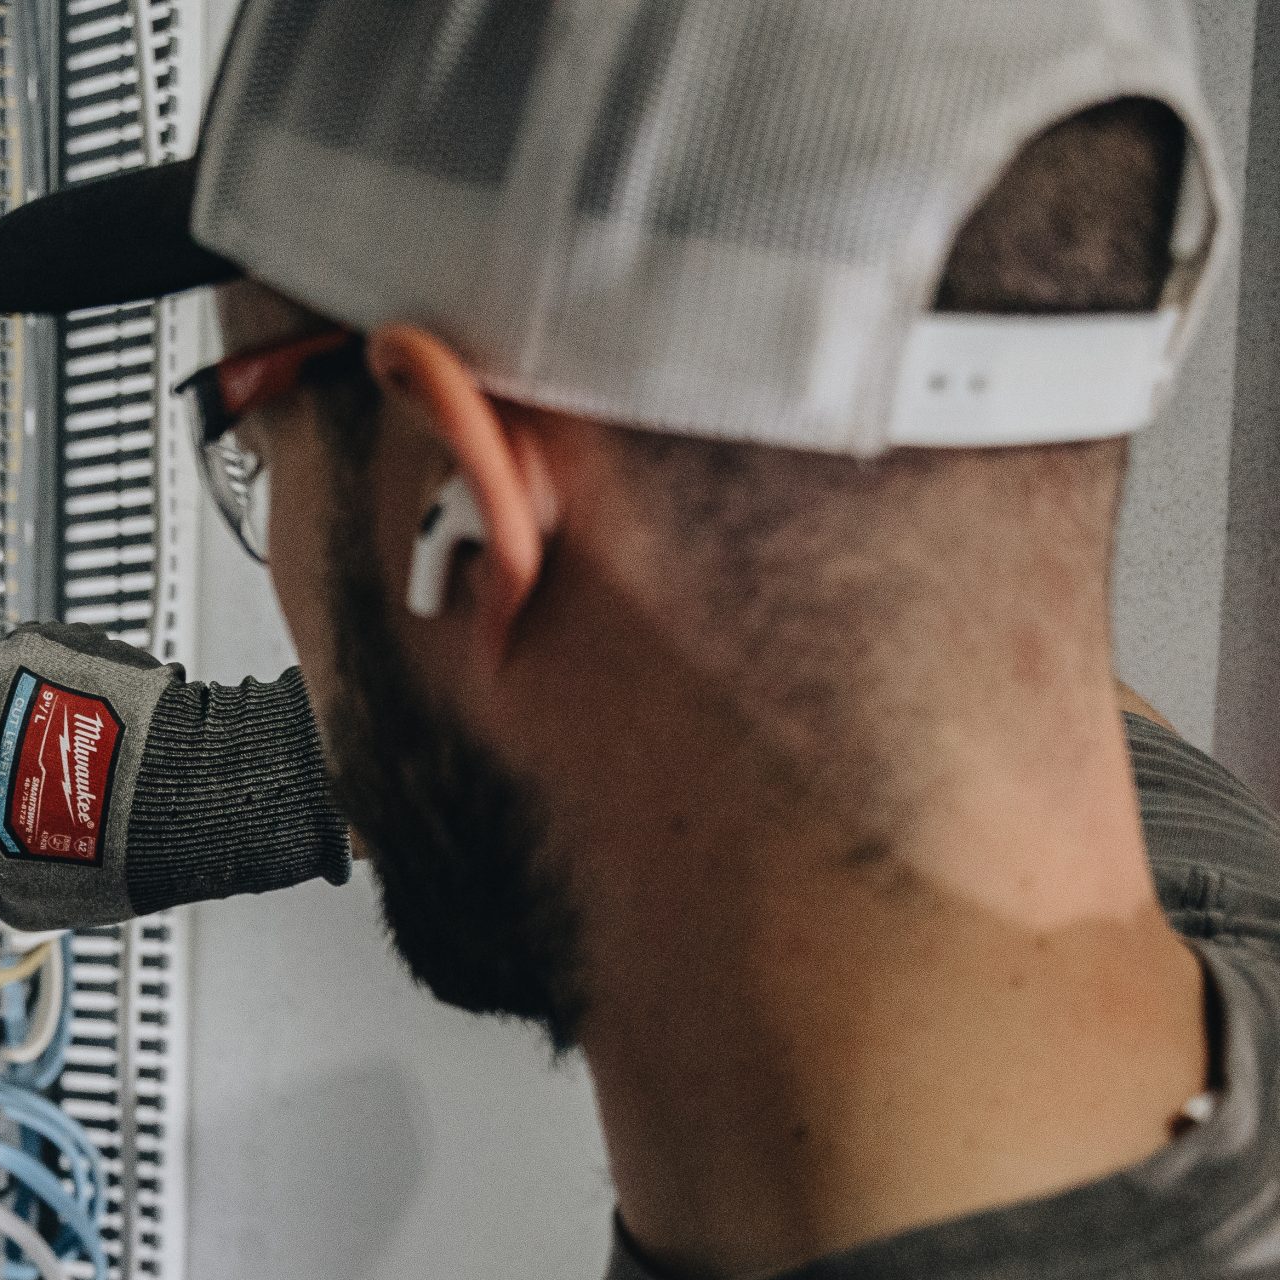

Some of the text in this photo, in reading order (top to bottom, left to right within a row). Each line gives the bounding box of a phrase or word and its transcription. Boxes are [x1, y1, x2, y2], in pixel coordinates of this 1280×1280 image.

[7, 697, 25, 726] CUT
[25, 776, 40, 833] SMARTSWIPE
[78, 840, 87, 853] A2
